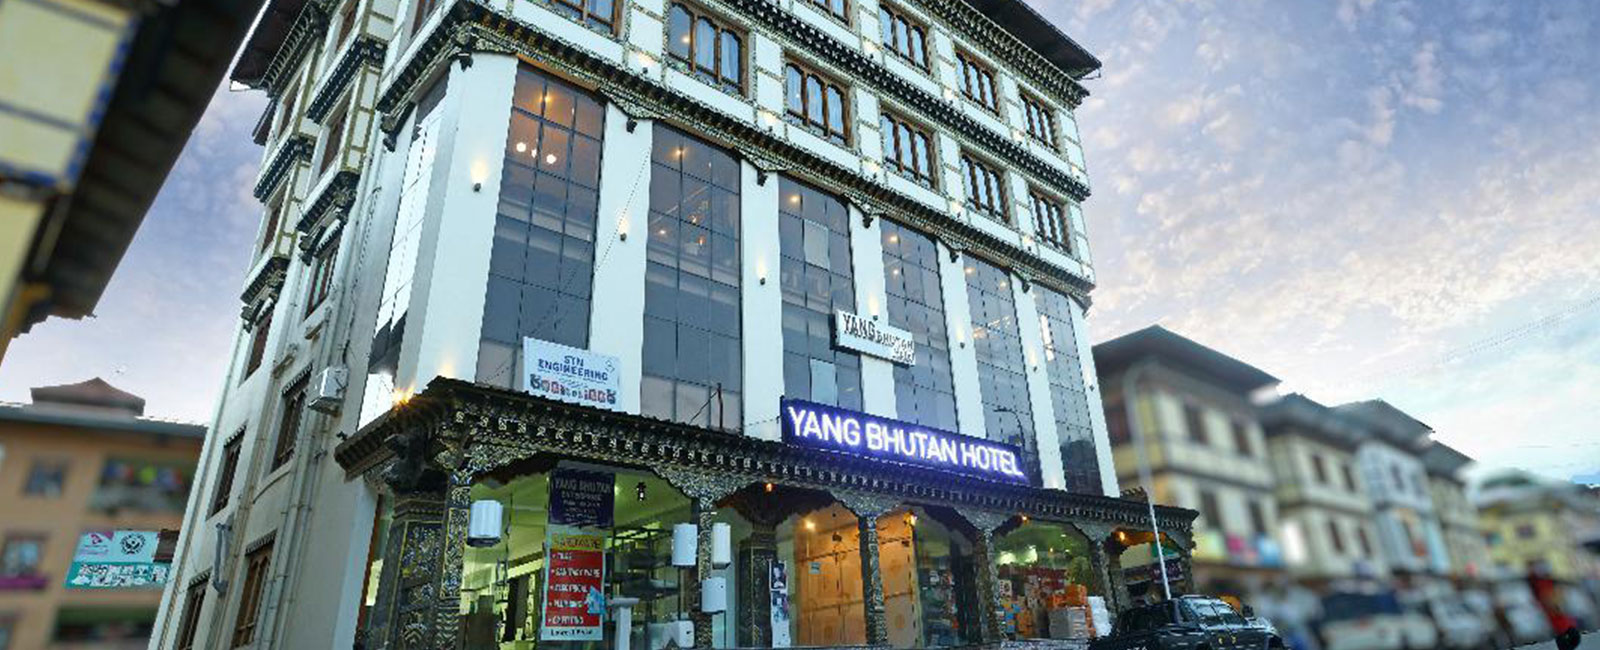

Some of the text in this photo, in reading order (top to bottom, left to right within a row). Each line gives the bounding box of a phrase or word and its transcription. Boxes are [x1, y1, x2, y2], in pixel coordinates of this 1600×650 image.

[843, 314, 875, 341] YANG
[538, 358, 608, 381] ENGINEERING
[787, 406, 1024, 477] YANG BHUTAN HOTEL
